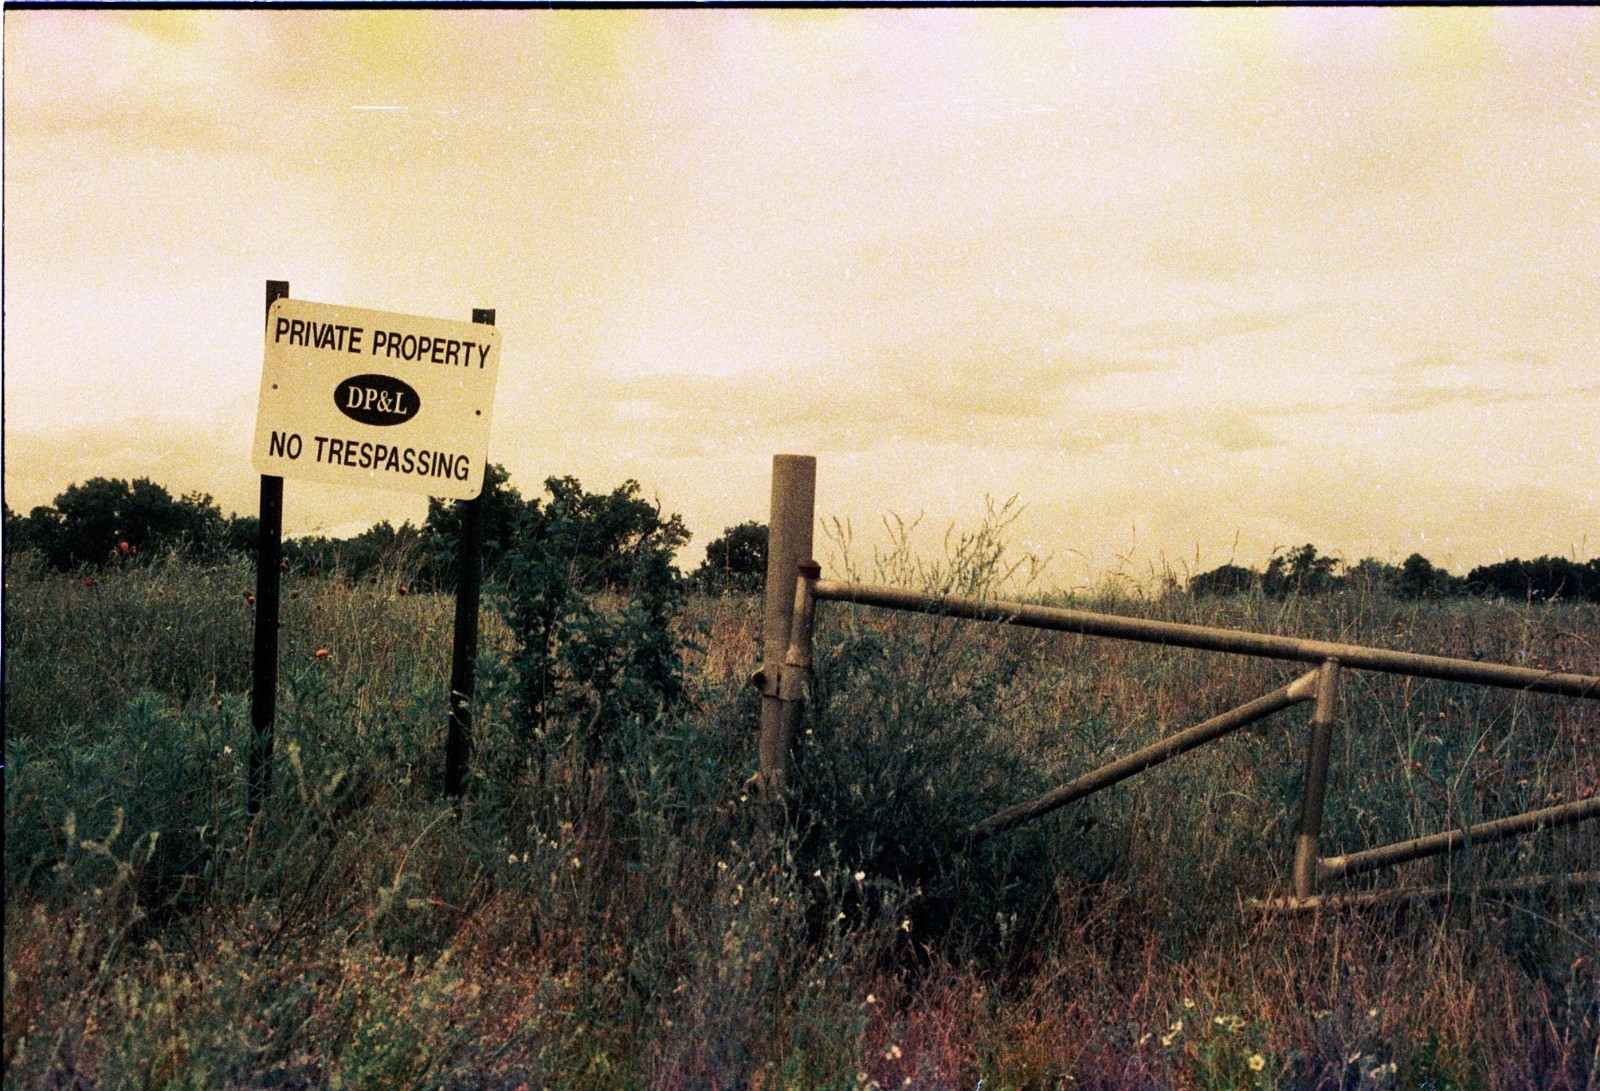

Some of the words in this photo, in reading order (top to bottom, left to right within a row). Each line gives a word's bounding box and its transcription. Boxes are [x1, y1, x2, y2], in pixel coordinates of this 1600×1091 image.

[275, 317, 364, 354] PRIVATE
[372, 330, 491, 369] PROPERTY
[346, 386, 408, 414] DP&L
[269, 430, 303, 460] NO
[314, 436, 470, 481] TRESPASSING
